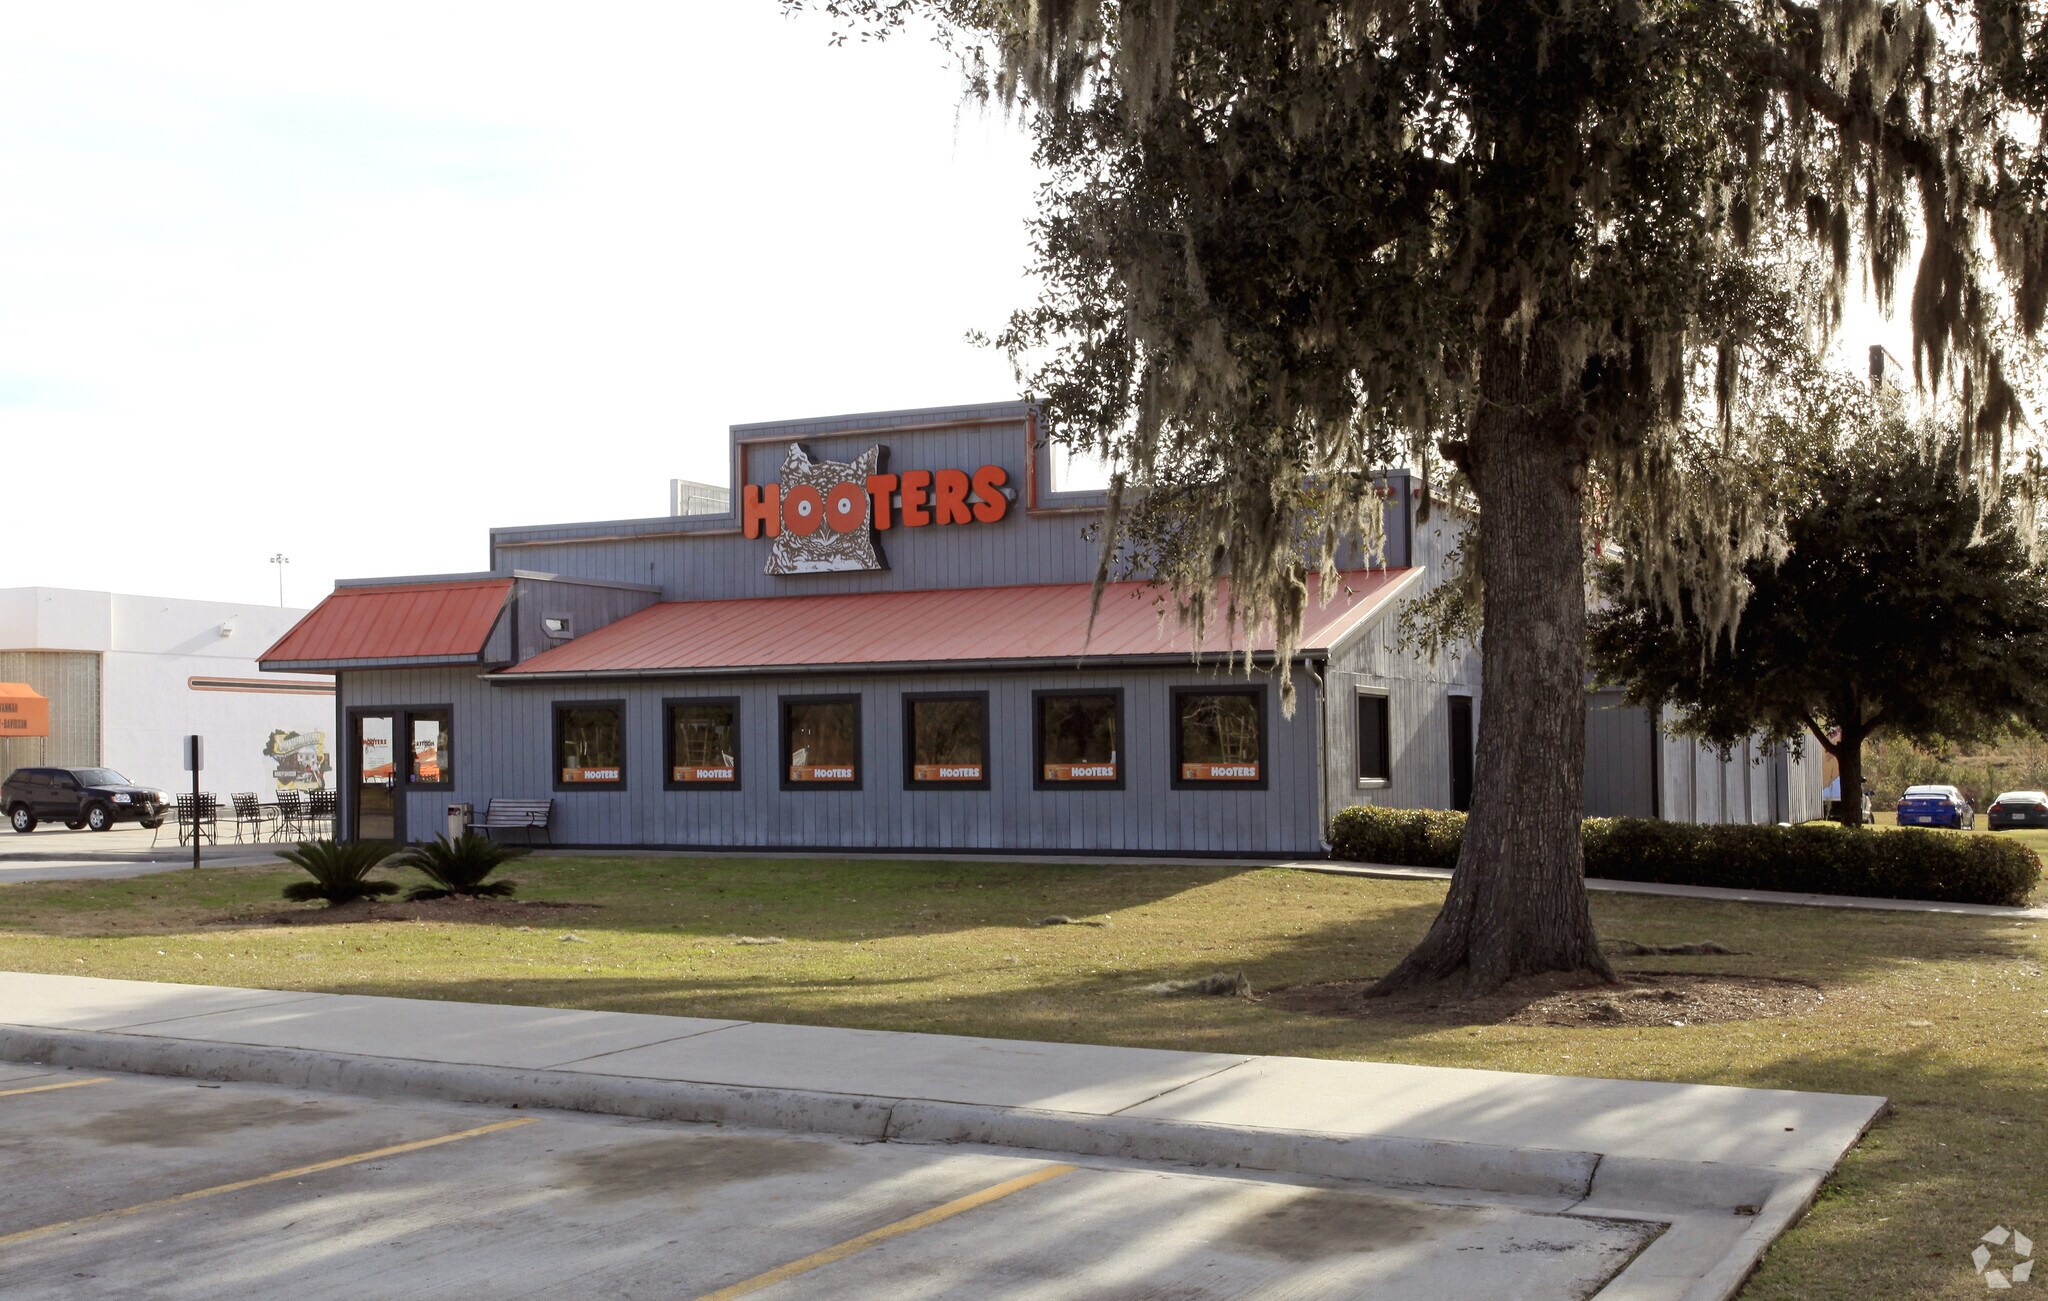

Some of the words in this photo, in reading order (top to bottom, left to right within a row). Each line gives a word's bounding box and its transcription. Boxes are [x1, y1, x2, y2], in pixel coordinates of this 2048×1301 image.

[743, 465, 1007, 539] HOOTERS
[584, 770, 619, 779] HOOTERS
[696, 769, 733, 779] HOOTERS
[814, 768, 852, 778] HOOTERS
[940, 767, 980, 778] HOOTERS
[1071, 767, 1114, 777] HOOTERS
[1211, 767, 1256, 777] HOOTERS
